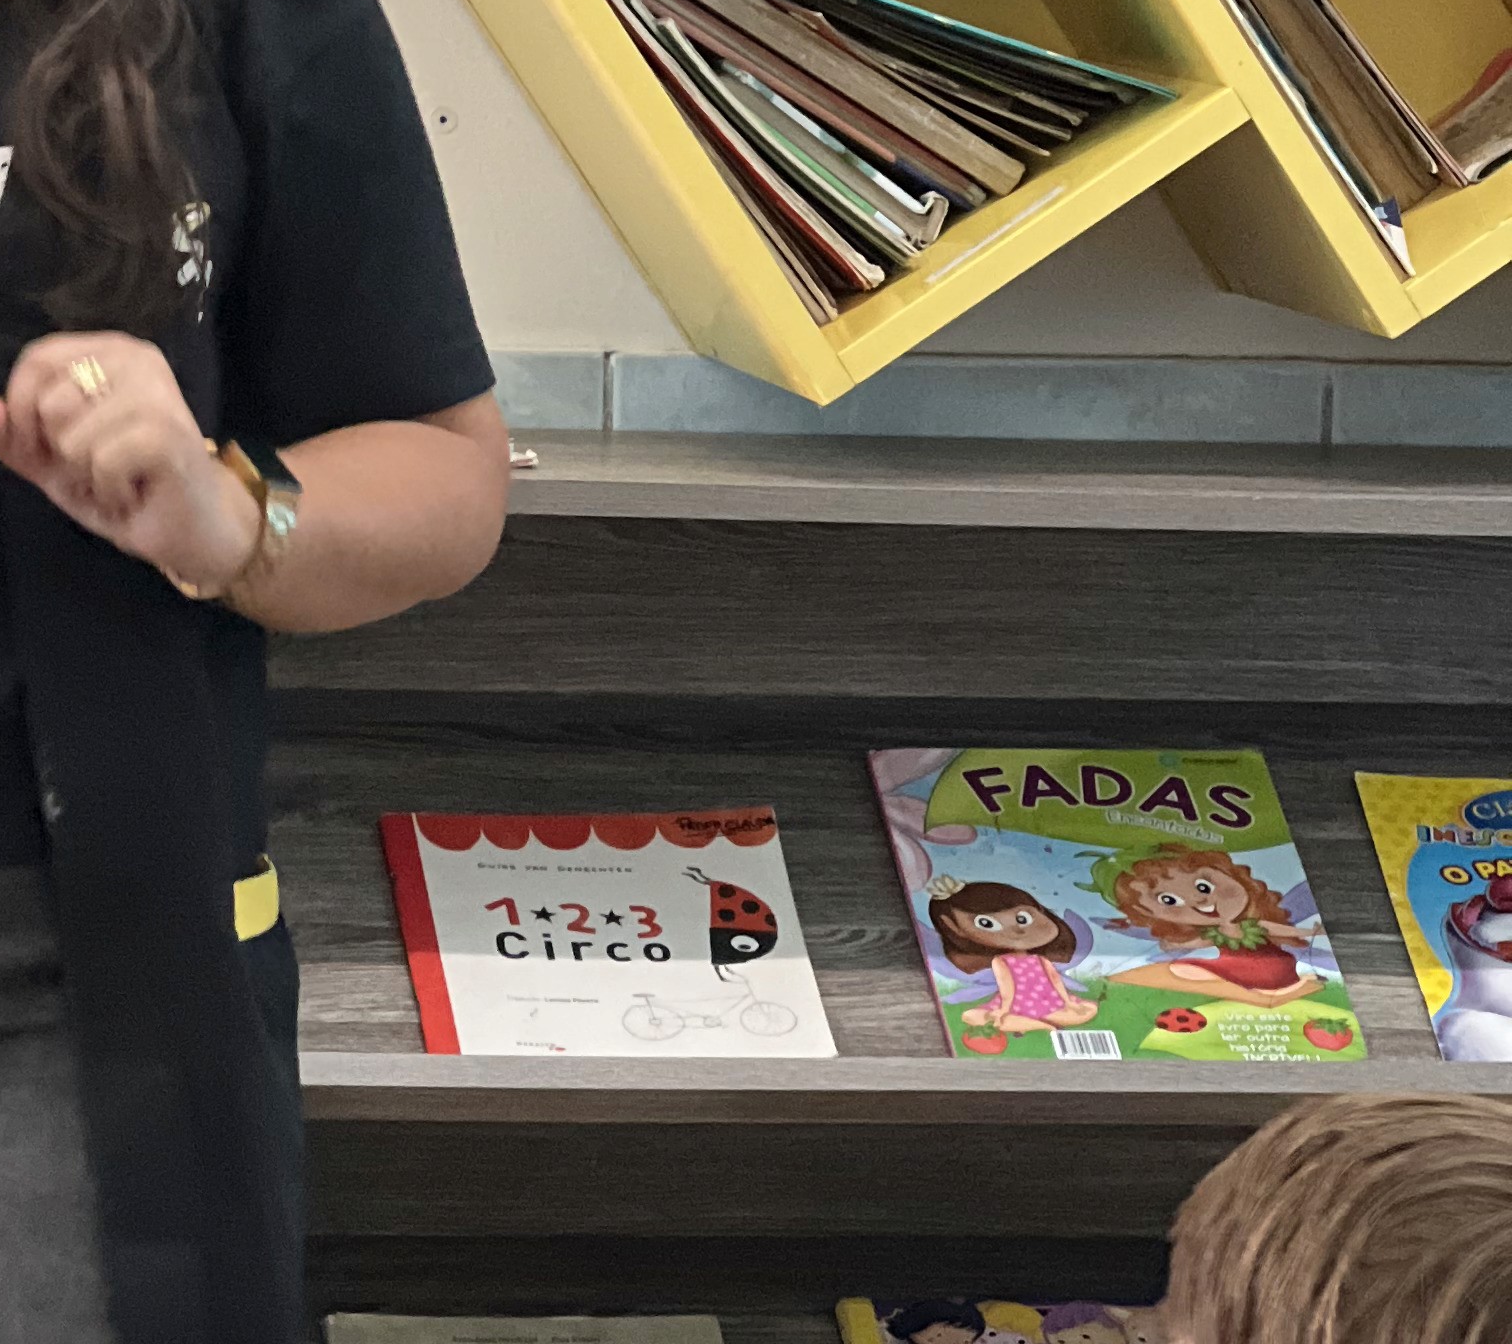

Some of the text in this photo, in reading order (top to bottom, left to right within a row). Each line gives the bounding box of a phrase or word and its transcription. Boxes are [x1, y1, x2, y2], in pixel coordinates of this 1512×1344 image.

[962, 764, 1256, 830] FADAS
[1472, 858, 1512, 880] PA
[496, 930, 672, 963] Circo
